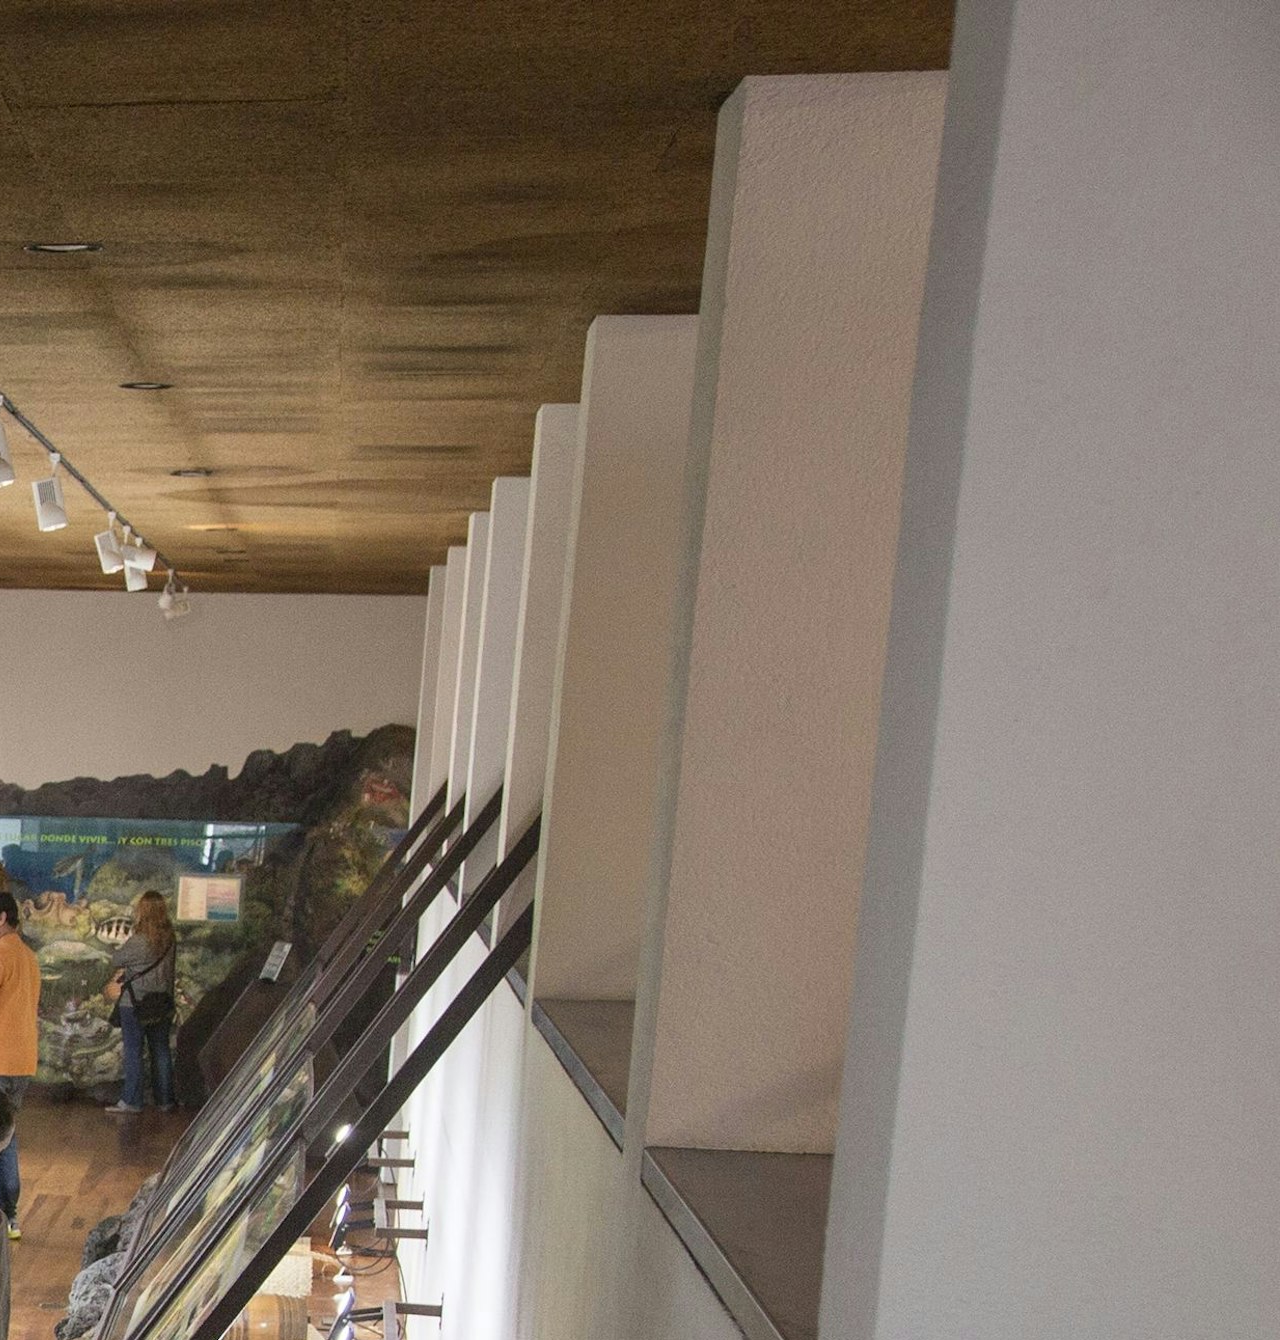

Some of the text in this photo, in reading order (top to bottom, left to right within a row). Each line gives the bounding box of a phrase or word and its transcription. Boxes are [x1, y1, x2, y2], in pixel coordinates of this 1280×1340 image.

[40, 833, 76, 844] DONDE
[129, 836, 153, 847] CON
[154, 836, 177, 847] TRES
